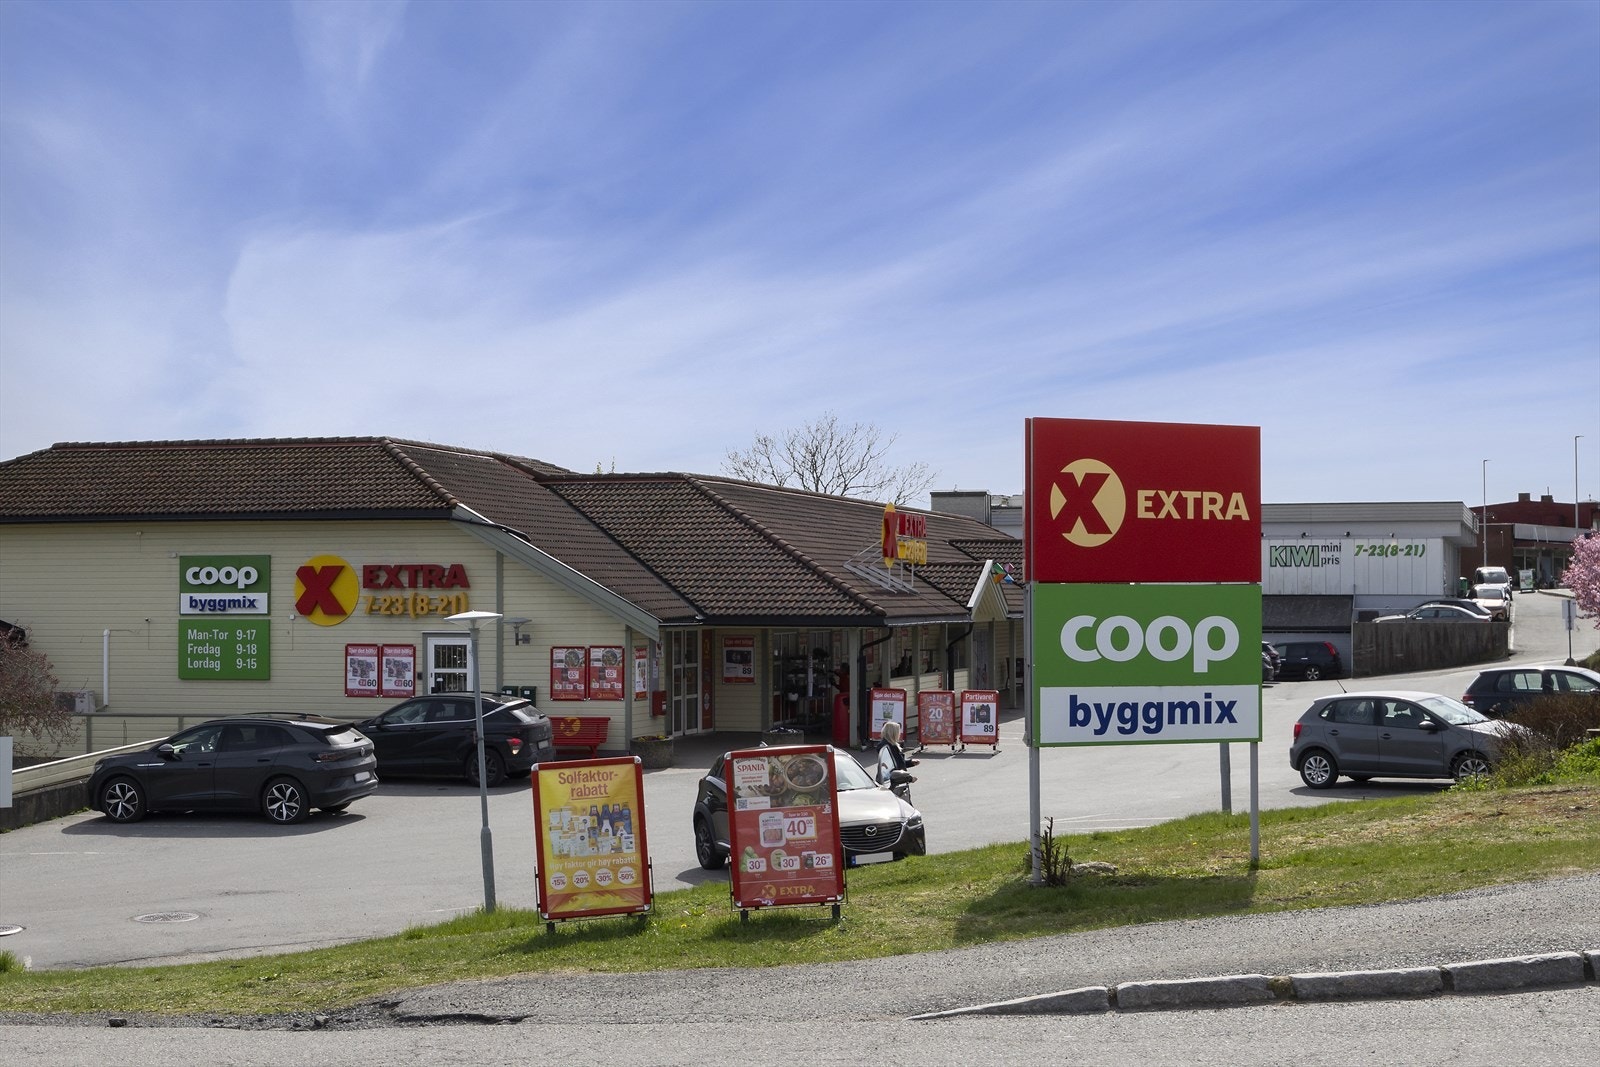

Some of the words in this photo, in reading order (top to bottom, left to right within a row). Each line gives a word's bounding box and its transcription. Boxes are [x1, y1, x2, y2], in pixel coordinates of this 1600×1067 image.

[1137, 489, 1250, 521] EXTRA
[1321, 542, 1342, 553] mini
[1354, 543, 1426, 558] 7-23(8-21)
[1269, 544, 1320, 568] KIWI
[1321, 555, 1340, 568] pris
[185, 566, 258, 589] coop
[362, 563, 471, 589] EXTRA
[189, 595, 258, 612] byggmix
[362, 594, 405, 616] 7-23
[187, 628, 229, 640] Man-Tor
[236, 629, 257, 641] 9-17
[187, 642, 221, 657] Fredag
[236, 643, 258, 655] 9-18
[1060, 614, 1240, 673] coop
[236, 658, 257, 669] 9-15
[367, 679, 377, 687] 60
[402, 679, 413, 687] 60
[965, 693, 994, 701] Partivare!
[928, 708, 943, 719] 20
[1069, 692, 1238, 736] byggmix
[983, 724, 994, 733] 89
[737, 763, 766, 773] SPANIA
[558, 770, 618, 785] Solfaktor-
[571, 783, 609, 798] rabatt
[786, 819, 807, 836] 40
[565, 859, 586, 869] faktor
[587, 860, 597, 868] gir
[749, 860, 761, 870] 30
[783, 858, 794, 868] 30
[780, 885, 816, 896] EXTRA
